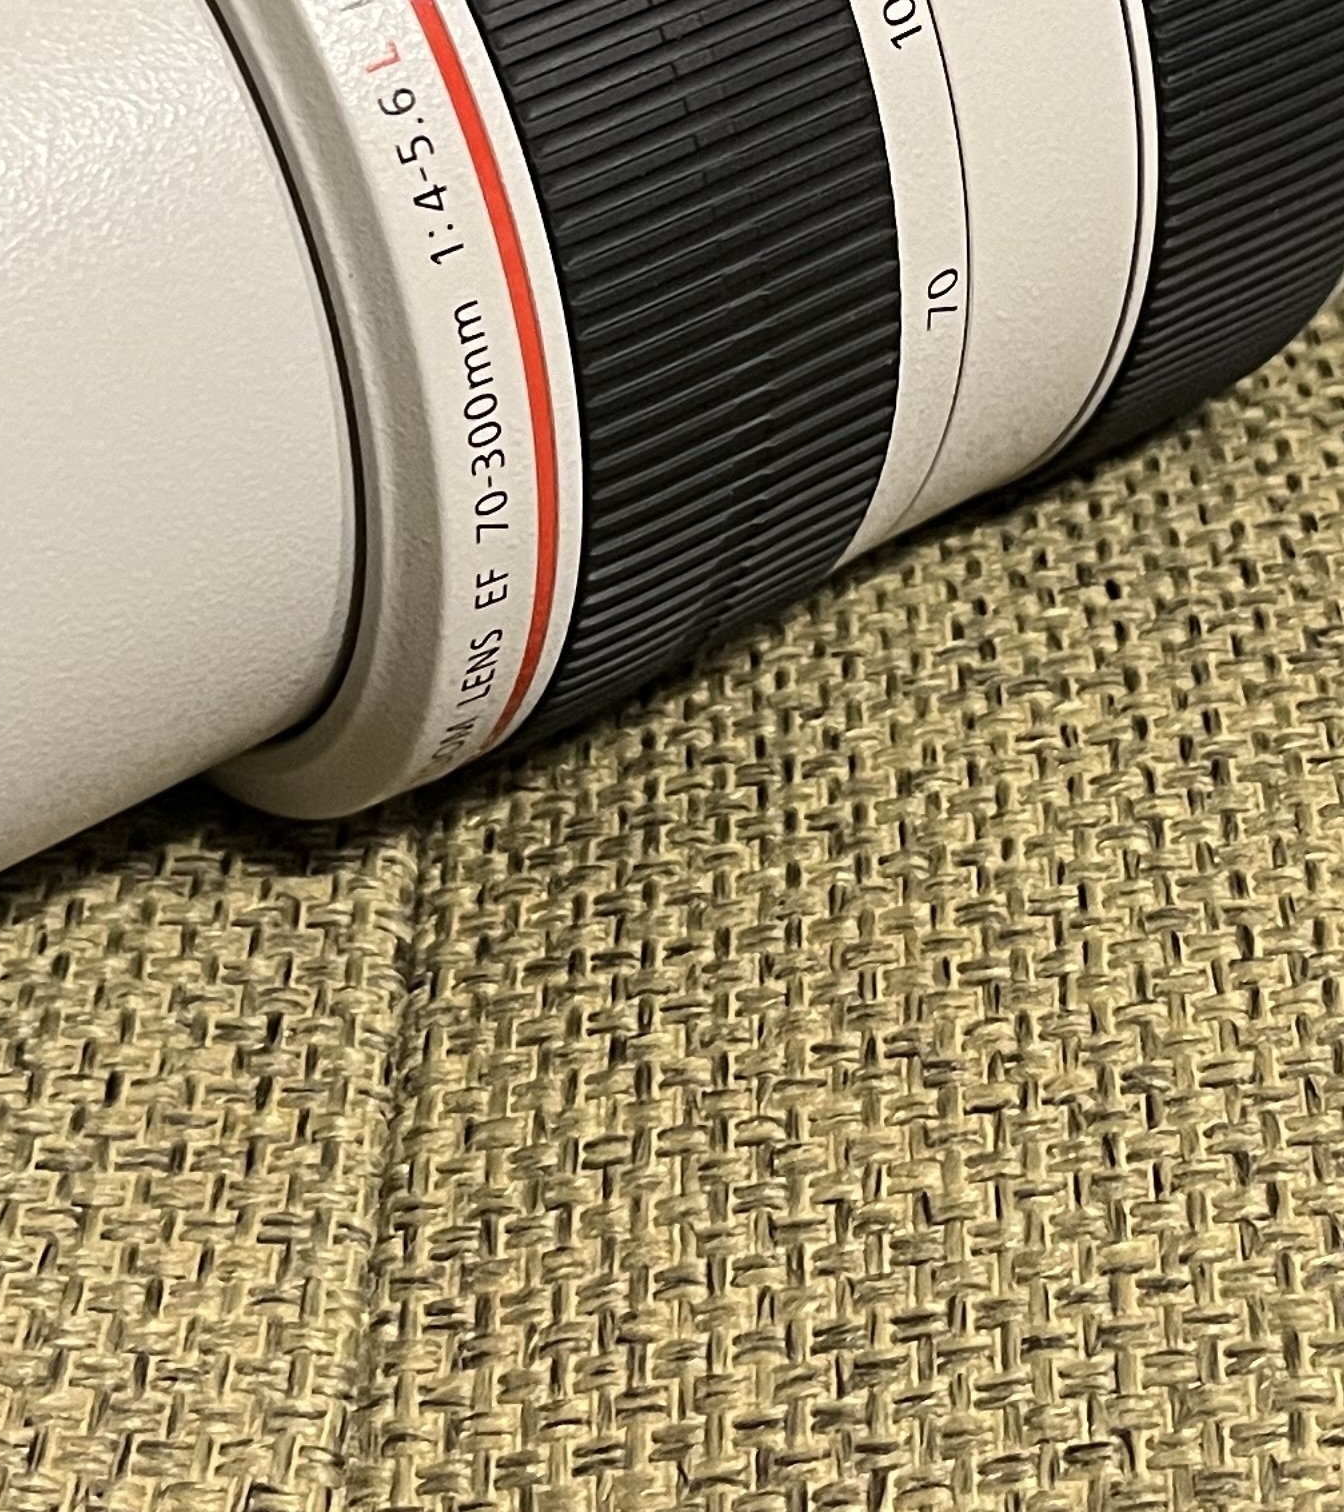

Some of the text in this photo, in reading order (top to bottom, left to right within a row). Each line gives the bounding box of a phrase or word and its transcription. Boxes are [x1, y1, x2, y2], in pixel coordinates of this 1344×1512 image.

[365, 39, 401, 74] L
[377, 87, 465, 266] 1:4-5.6
[926, 267, 959, 332] 70
[453, 299, 509, 545] 70-300mm
[474, 568, 509, 610] EF
[456, 628, 504, 707] LENS
